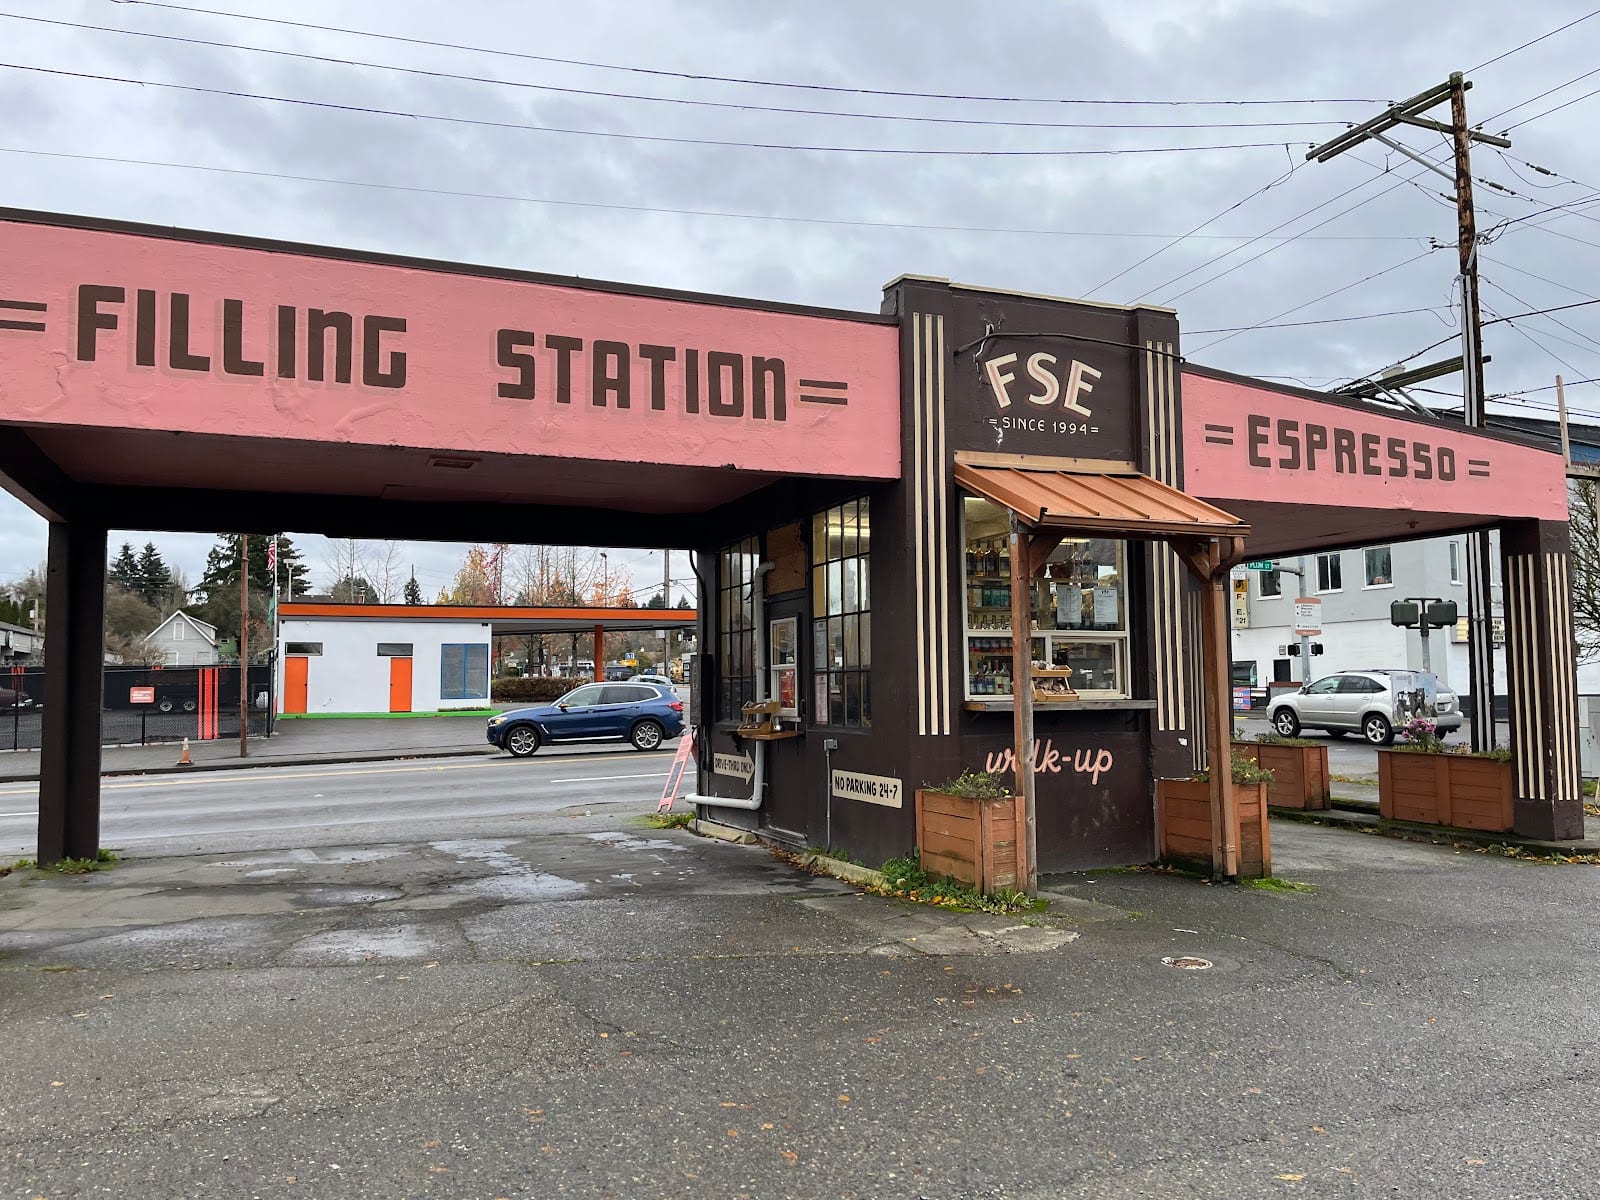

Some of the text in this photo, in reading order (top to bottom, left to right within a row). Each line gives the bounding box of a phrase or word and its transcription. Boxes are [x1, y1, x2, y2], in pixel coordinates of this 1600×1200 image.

[77, 284, 786, 421] FILLING STATION
[985, 352, 1102, 418] FSE
[1002, 416, 1087, 436] SINCE 1994
[1247, 414, 1456, 482] ESPRESSO
[714, 757, 739, 772] DRIVE-THRU
[986, 739, 1113, 785] wlk-up
[834, 775, 898, 799] NO PARKING 24-7
